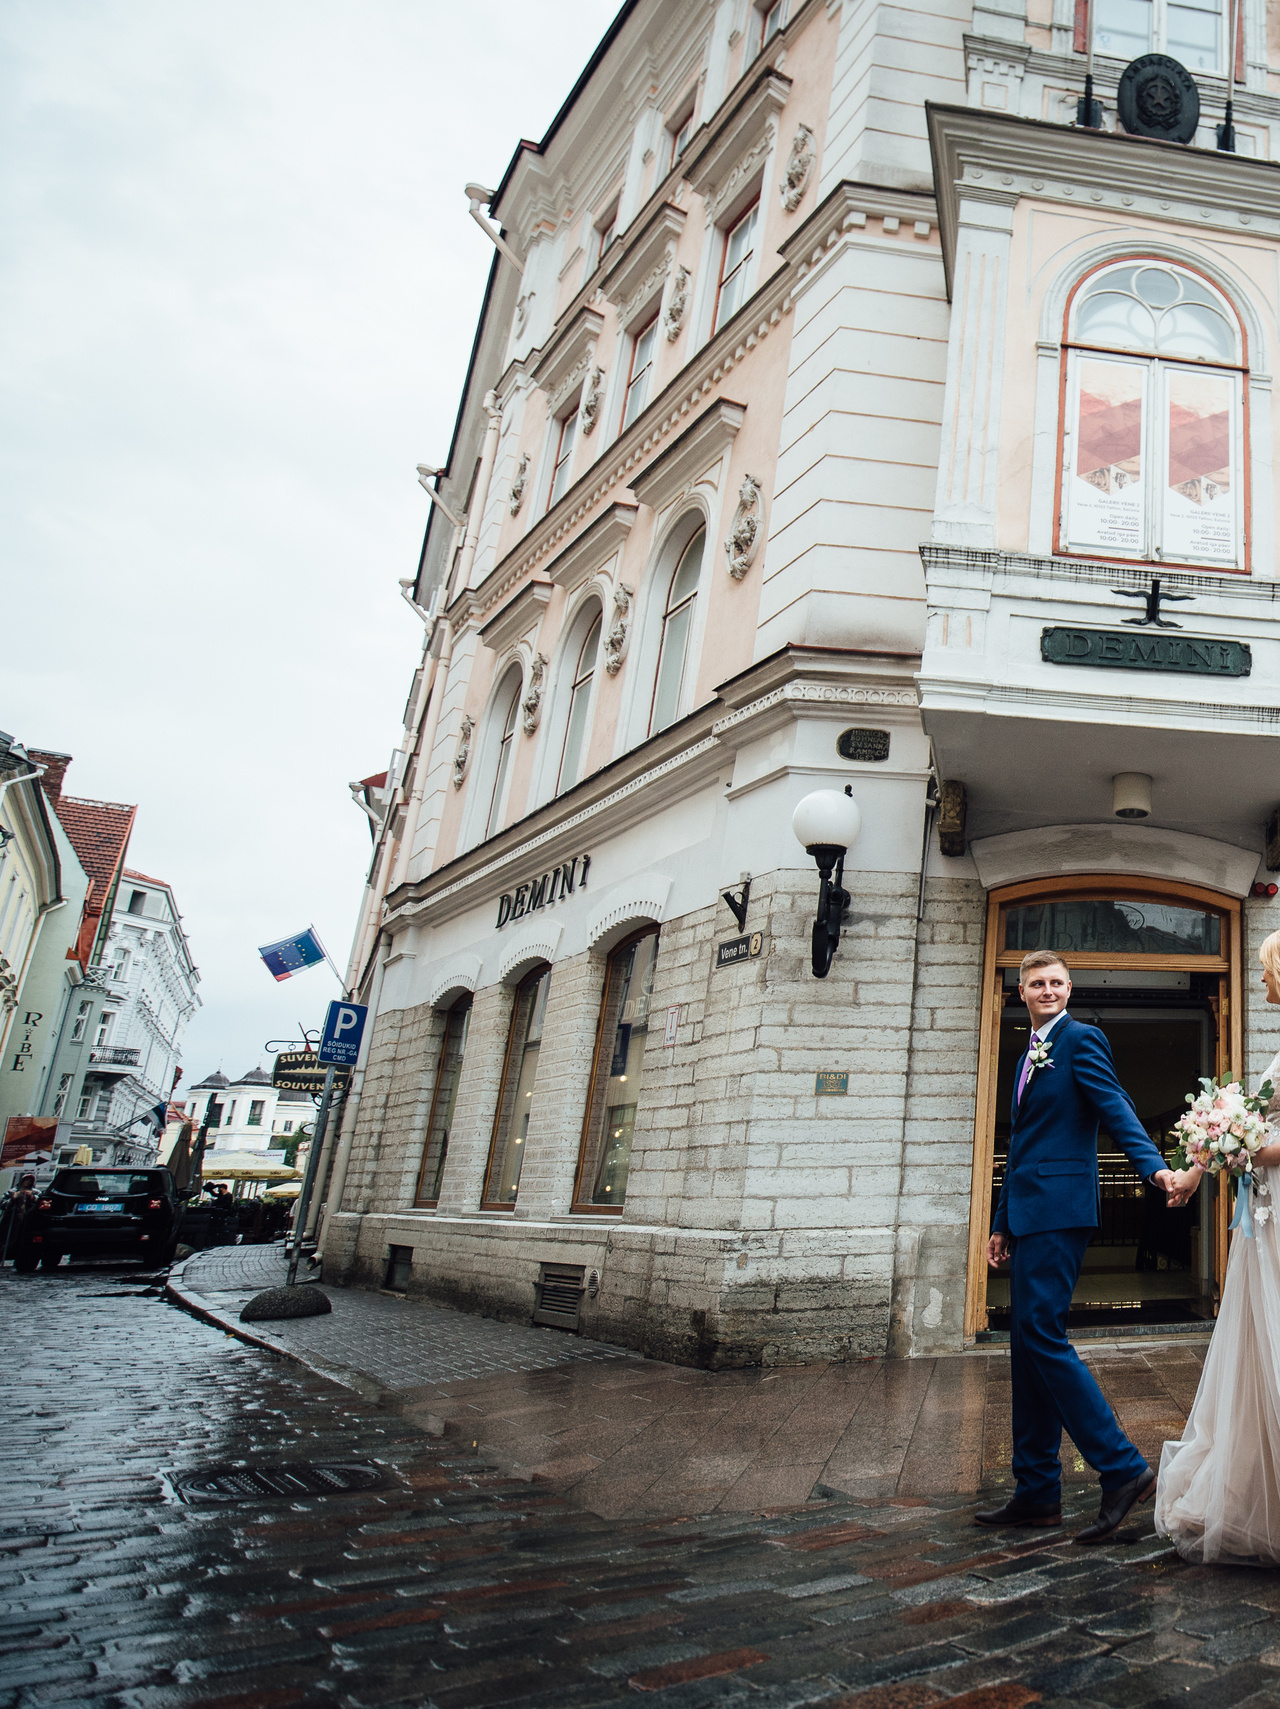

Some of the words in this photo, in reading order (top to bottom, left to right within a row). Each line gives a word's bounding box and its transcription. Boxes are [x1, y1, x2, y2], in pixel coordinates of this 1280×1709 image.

[721, 947, 738, 960] Vene
[738, 943, 748, 955] tn.
[754, 938, 759, 950] 2
[333, 1007, 358, 1039] P
[280, 1053, 319, 1063] SUVEN
[274, 1080, 345, 1091] SOUVENRS
